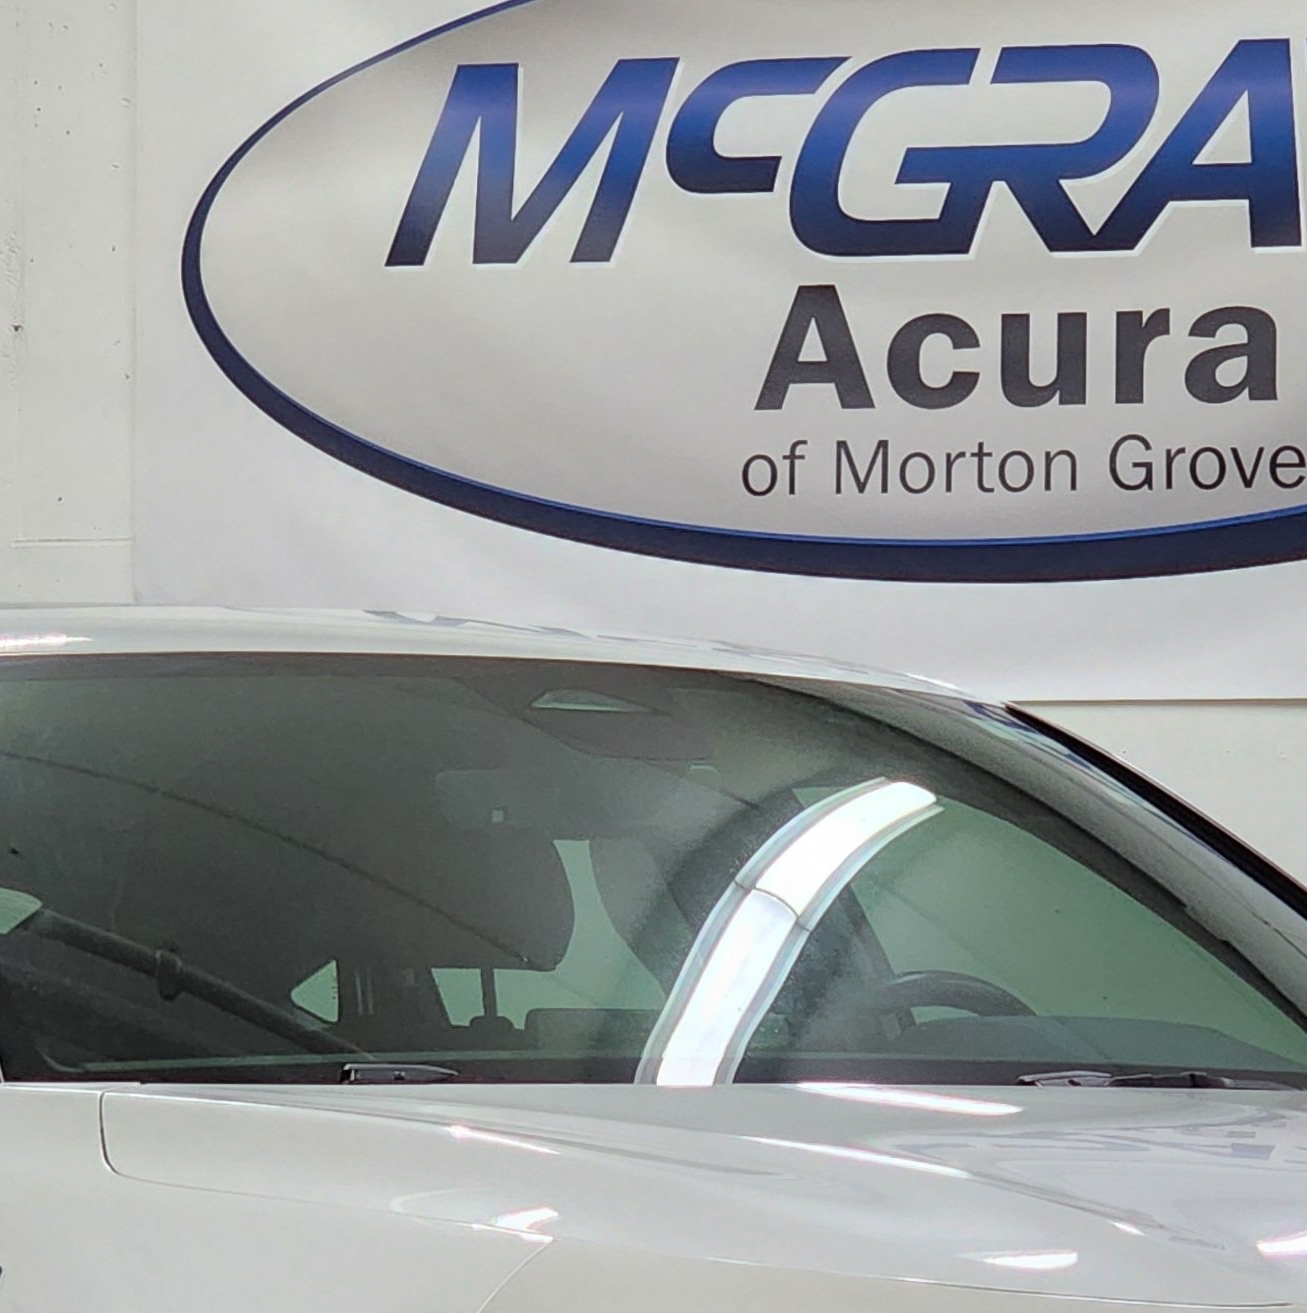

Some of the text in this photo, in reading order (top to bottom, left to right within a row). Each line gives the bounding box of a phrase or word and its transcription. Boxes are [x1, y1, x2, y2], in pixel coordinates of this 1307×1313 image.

[754, 284, 1280, 412] Acura
[741, 433, 1307, 498] of Morton Grove
